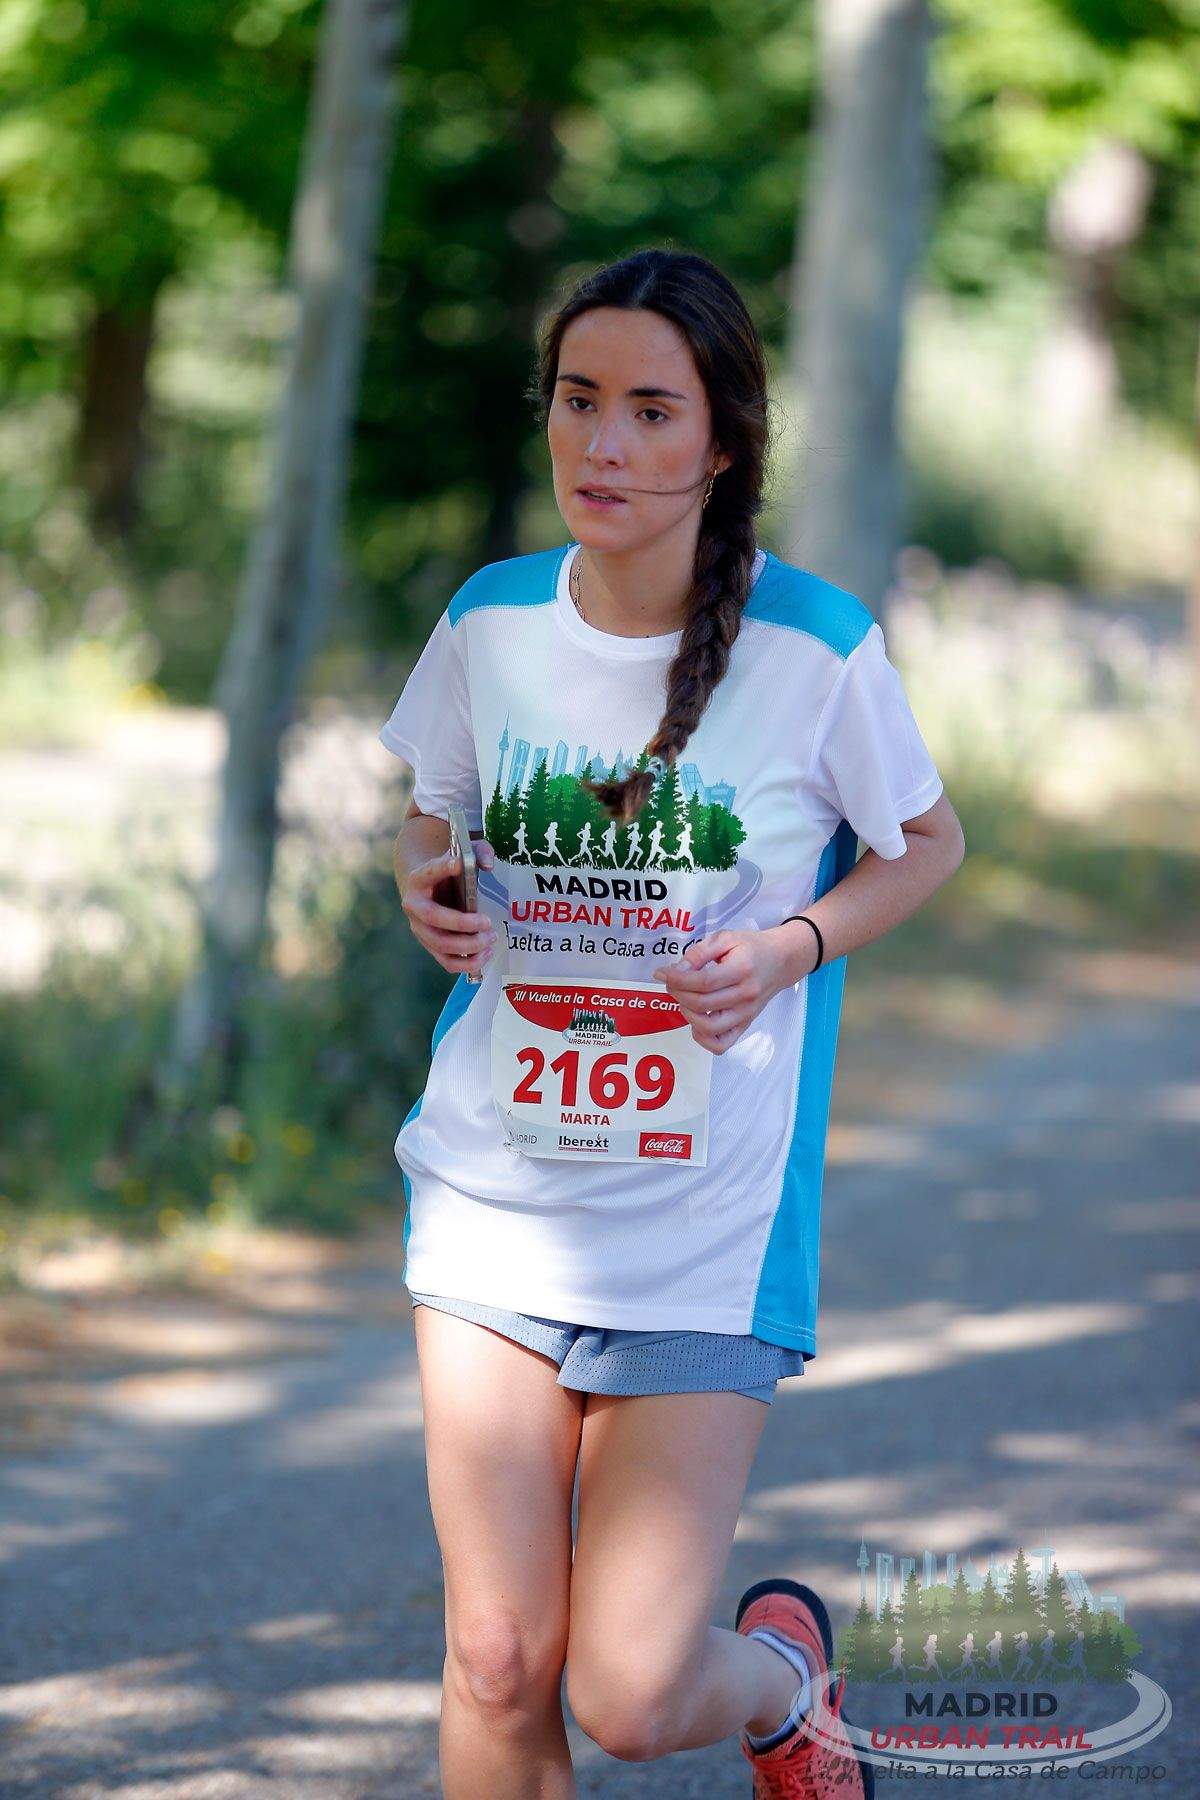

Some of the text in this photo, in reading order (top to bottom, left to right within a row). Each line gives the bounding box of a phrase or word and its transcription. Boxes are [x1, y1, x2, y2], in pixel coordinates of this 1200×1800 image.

[535, 874, 668, 901] MADRID
[511, 901, 695, 932] URBAN TRAIL
[560, 938, 572, 952] a
[579, 934, 596, 953] la
[603, 937, 645, 957] Casa
[652, 937, 679, 955] de
[513, 990, 681, 1011] XII Vuelta a la Casa de Cam
[575, 1032, 606, 1040] MADRID
[513, 1047, 675, 1111] 2169
[560, 1113, 610, 1126] MARTA
[558, 1134, 609, 1148] Iberext
